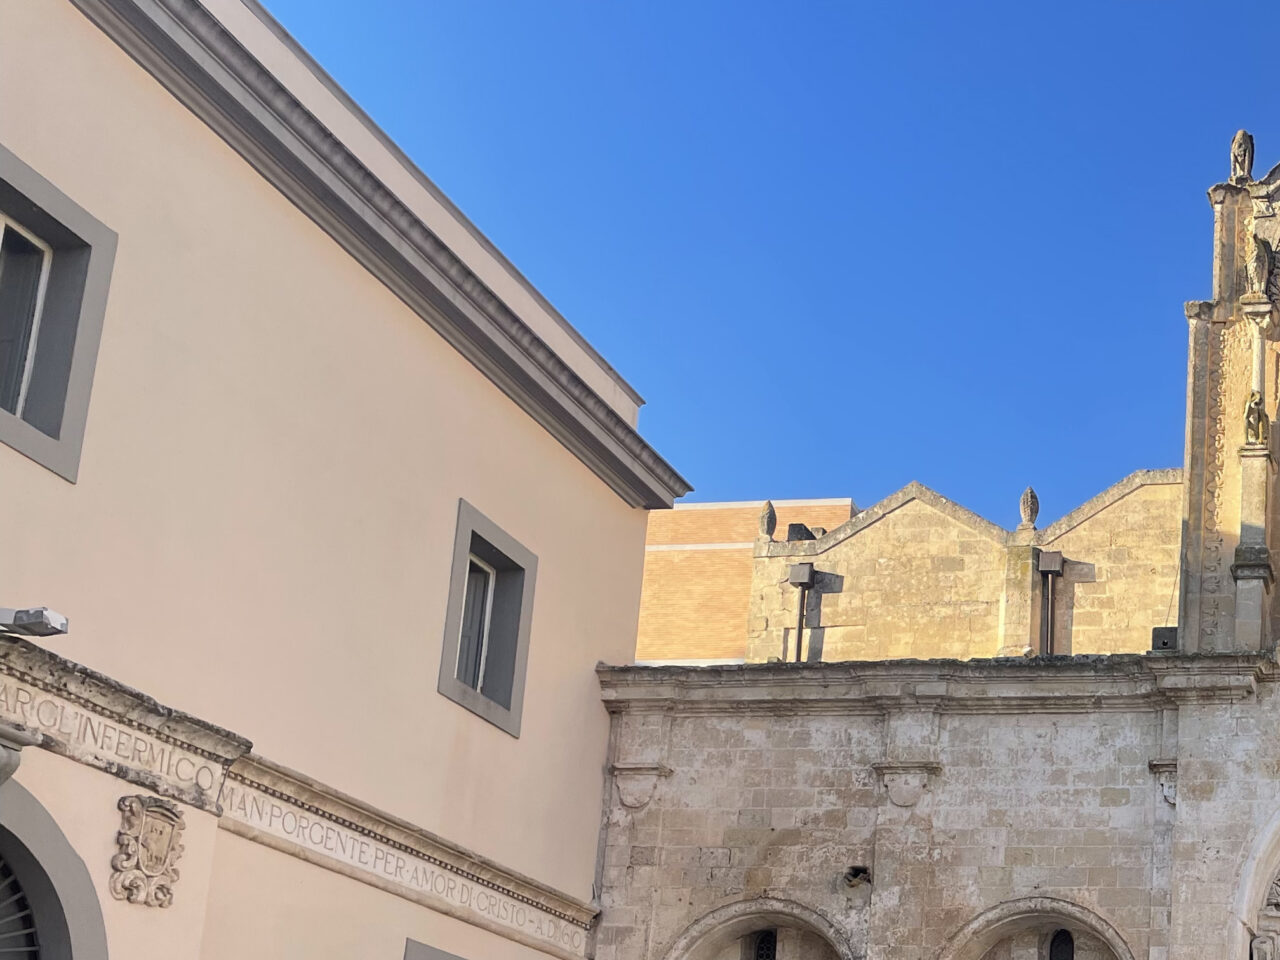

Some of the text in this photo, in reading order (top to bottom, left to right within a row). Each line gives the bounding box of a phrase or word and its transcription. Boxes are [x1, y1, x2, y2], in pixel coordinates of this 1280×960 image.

[268, 803, 370, 866] PORGENTE
[373, 847, 407, 880] PER
[411, 865, 456, 899] AMOR
[475, 891, 526, 927] CRISTO
